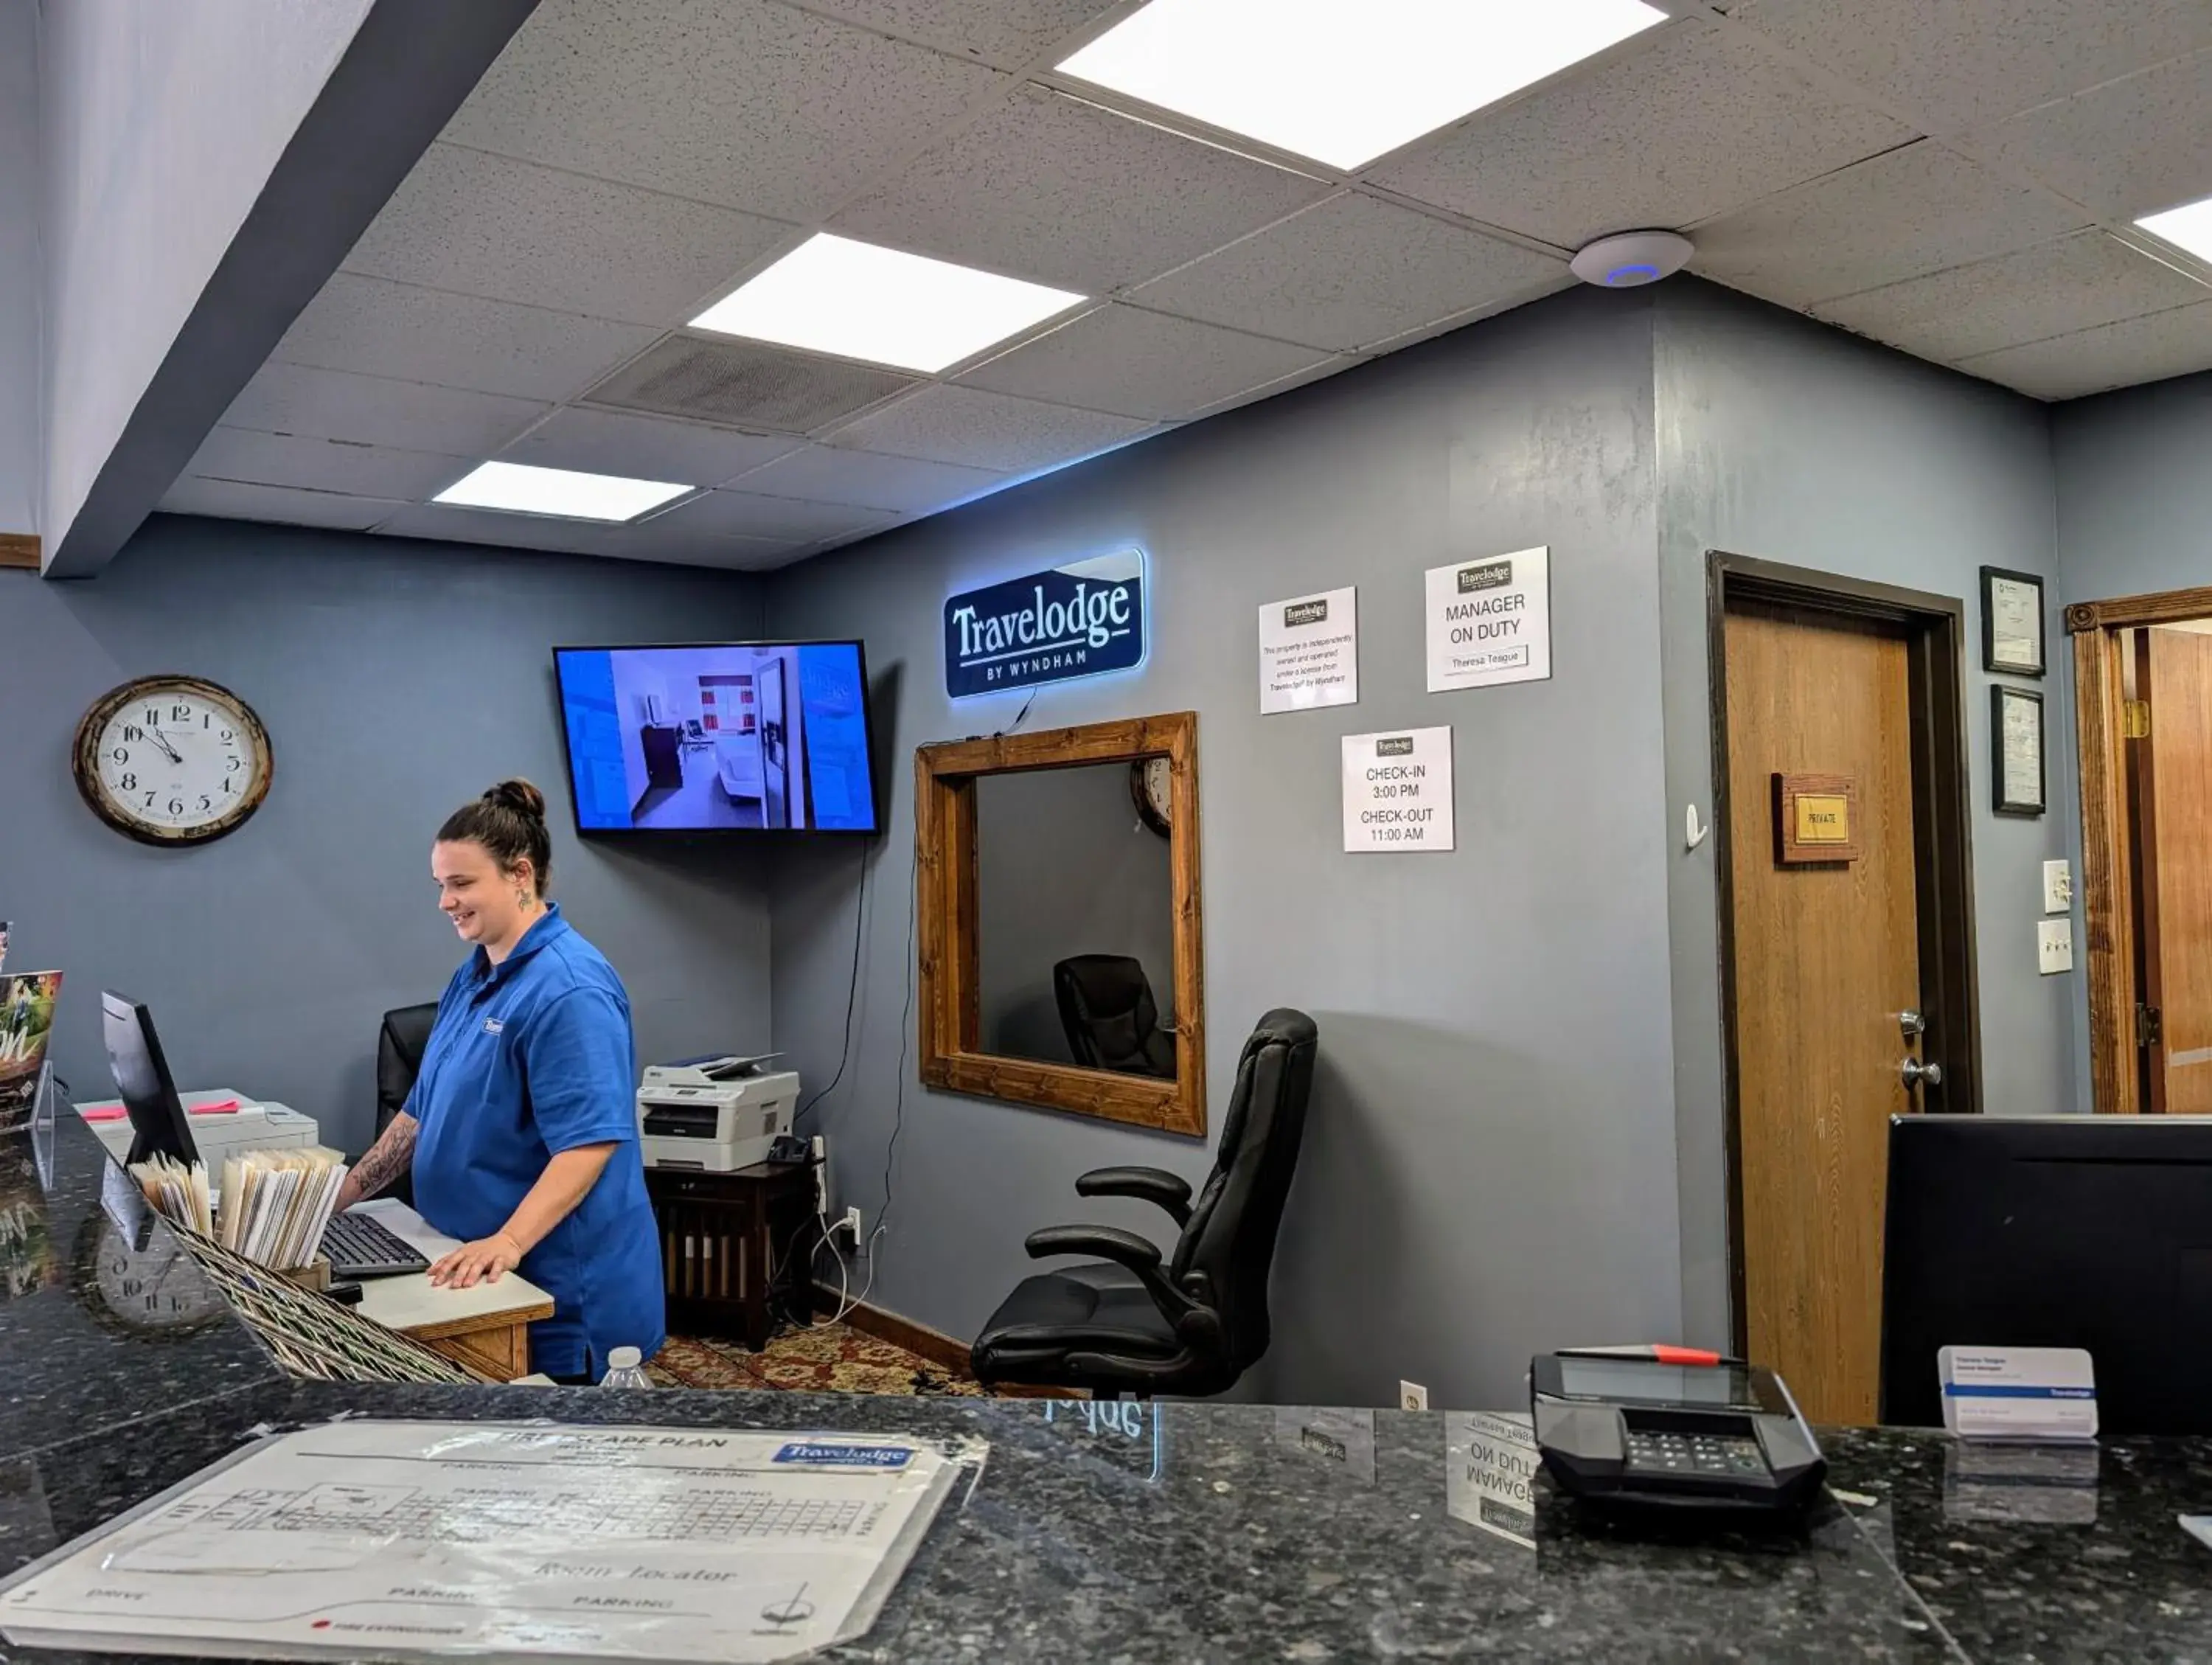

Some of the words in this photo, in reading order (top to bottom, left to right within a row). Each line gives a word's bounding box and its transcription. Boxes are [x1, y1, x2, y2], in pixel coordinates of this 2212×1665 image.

[1460, 567, 1509, 583] Travelodge
[1446, 594, 1525, 622] MANAGER
[953, 583, 1130, 656] Travelodge
[1450, 627, 1472, 644] ON
[1478, 619, 1520, 640] DUTY
[987, 665, 1003, 681] BY
[1009, 650, 1087, 677] WYNDHAM
[1488, 652, 1518, 664] Teague
[147, 709, 159, 726] 11
[172, 704, 190, 722] 12
[203, 714, 209, 729] 1
[124, 725, 142, 743] 10
[220, 730, 232, 746] 2
[114, 747, 129, 765] 9
[1366, 765, 1425, 781] CHECK-IN
[121, 773, 136, 790] 8
[145, 791, 156, 807] 7
[1373, 785, 1397, 799] 3:00
[1400, 784, 1419, 797] PM
[168, 797, 183, 815] 6
[195, 795, 210, 810] 5
[1360, 808, 1433, 824] CHECK-OUT
[1808, 813, 1837, 824] PRIVATE
[1371, 828, 1401, 841] 11:00
[1404, 827, 1424, 840] AM
[659, 1437, 728, 1447] PLAN
[789, 1445, 905, 1461] Travelodge
[627, 1563, 738, 1582] Locator
[573, 1596, 674, 1609] PARKING
